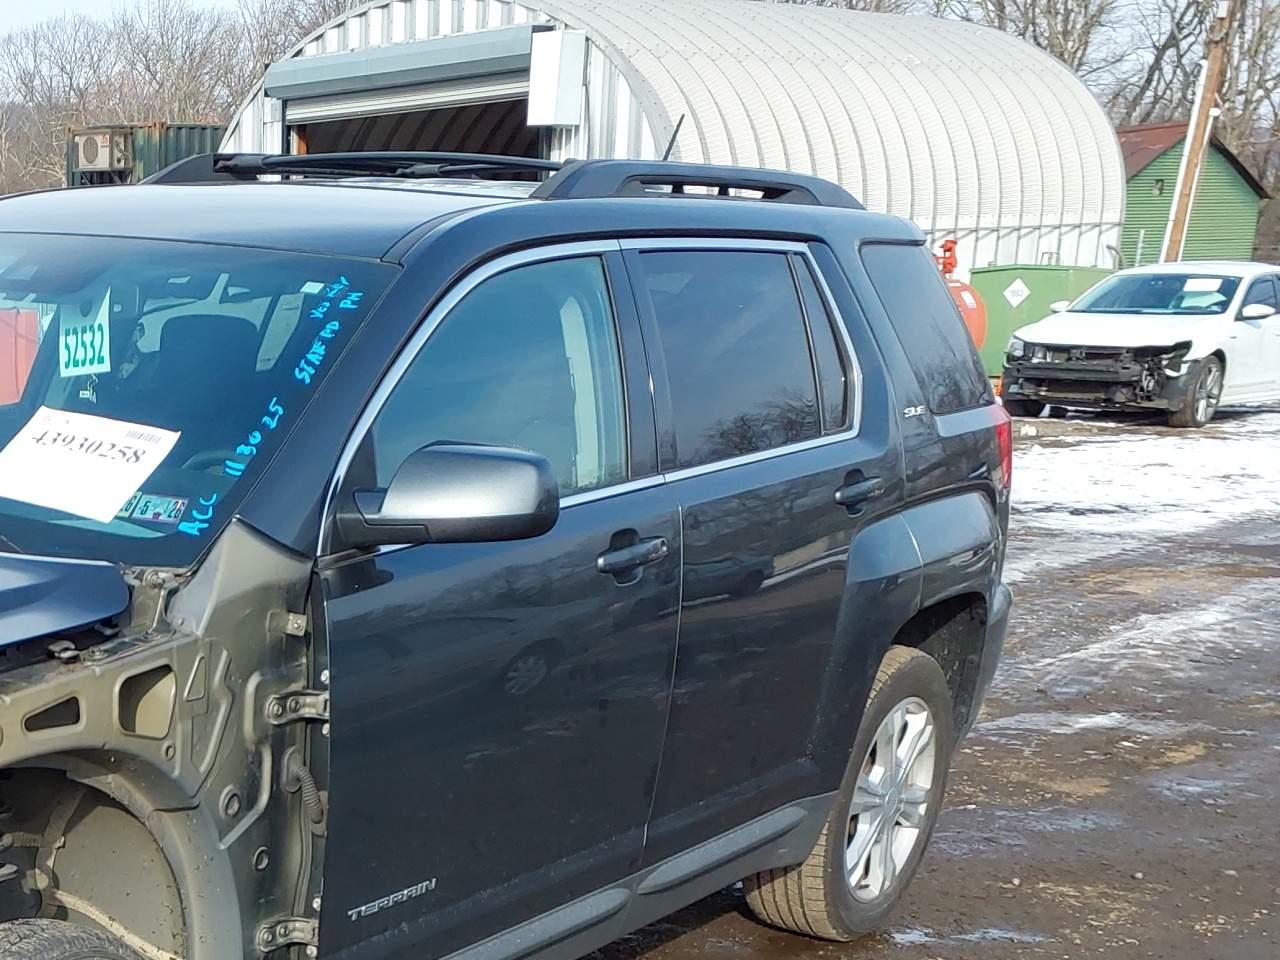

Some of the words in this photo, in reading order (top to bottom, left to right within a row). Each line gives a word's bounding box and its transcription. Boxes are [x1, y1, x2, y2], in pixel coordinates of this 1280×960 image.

[64, 322, 105, 369] 52532
[32, 430, 146, 464] 43930258
[347, 877, 437, 921] TERRAIN
